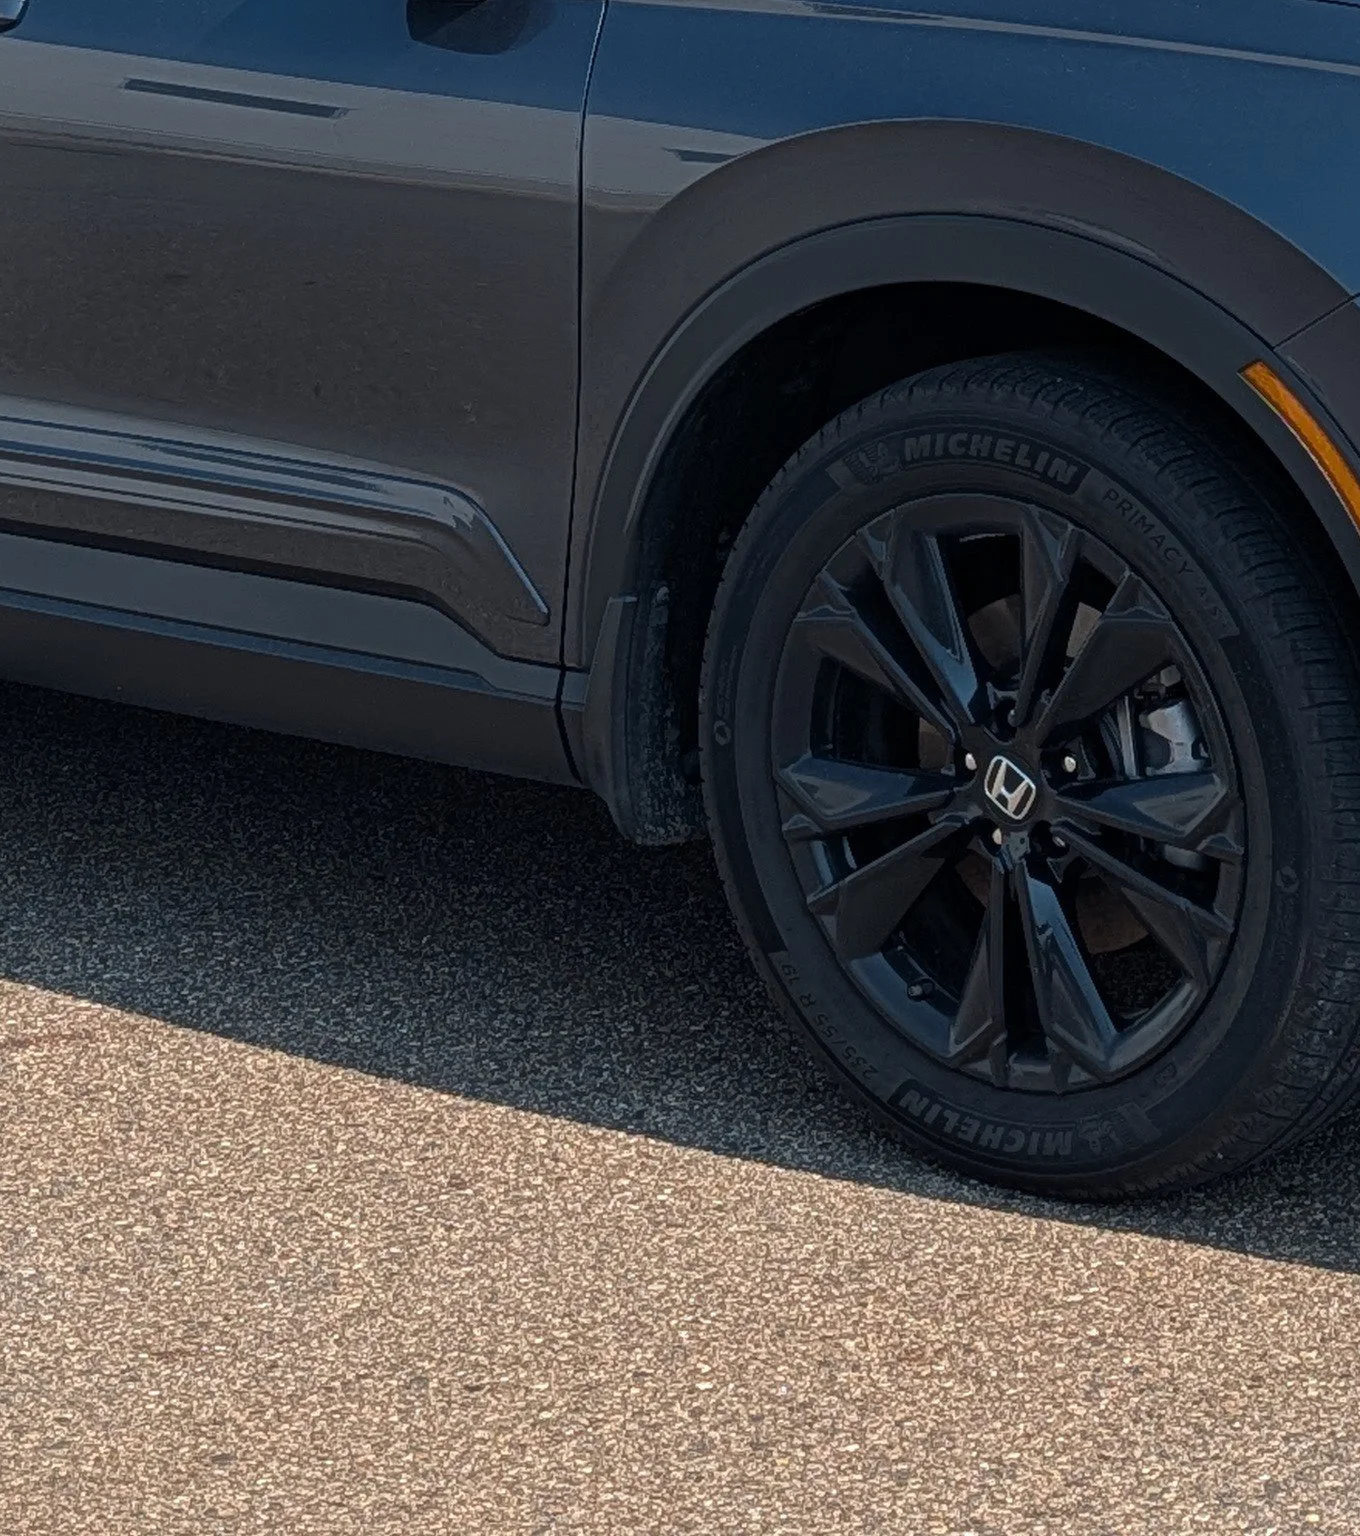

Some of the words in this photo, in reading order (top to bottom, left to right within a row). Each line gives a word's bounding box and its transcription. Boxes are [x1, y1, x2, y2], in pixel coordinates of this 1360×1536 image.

[904, 432, 1079, 487] MICHELIN
[1101, 486, 1197, 576] PRIMACY
[896, 1087, 1075, 1158] MICHELIN
